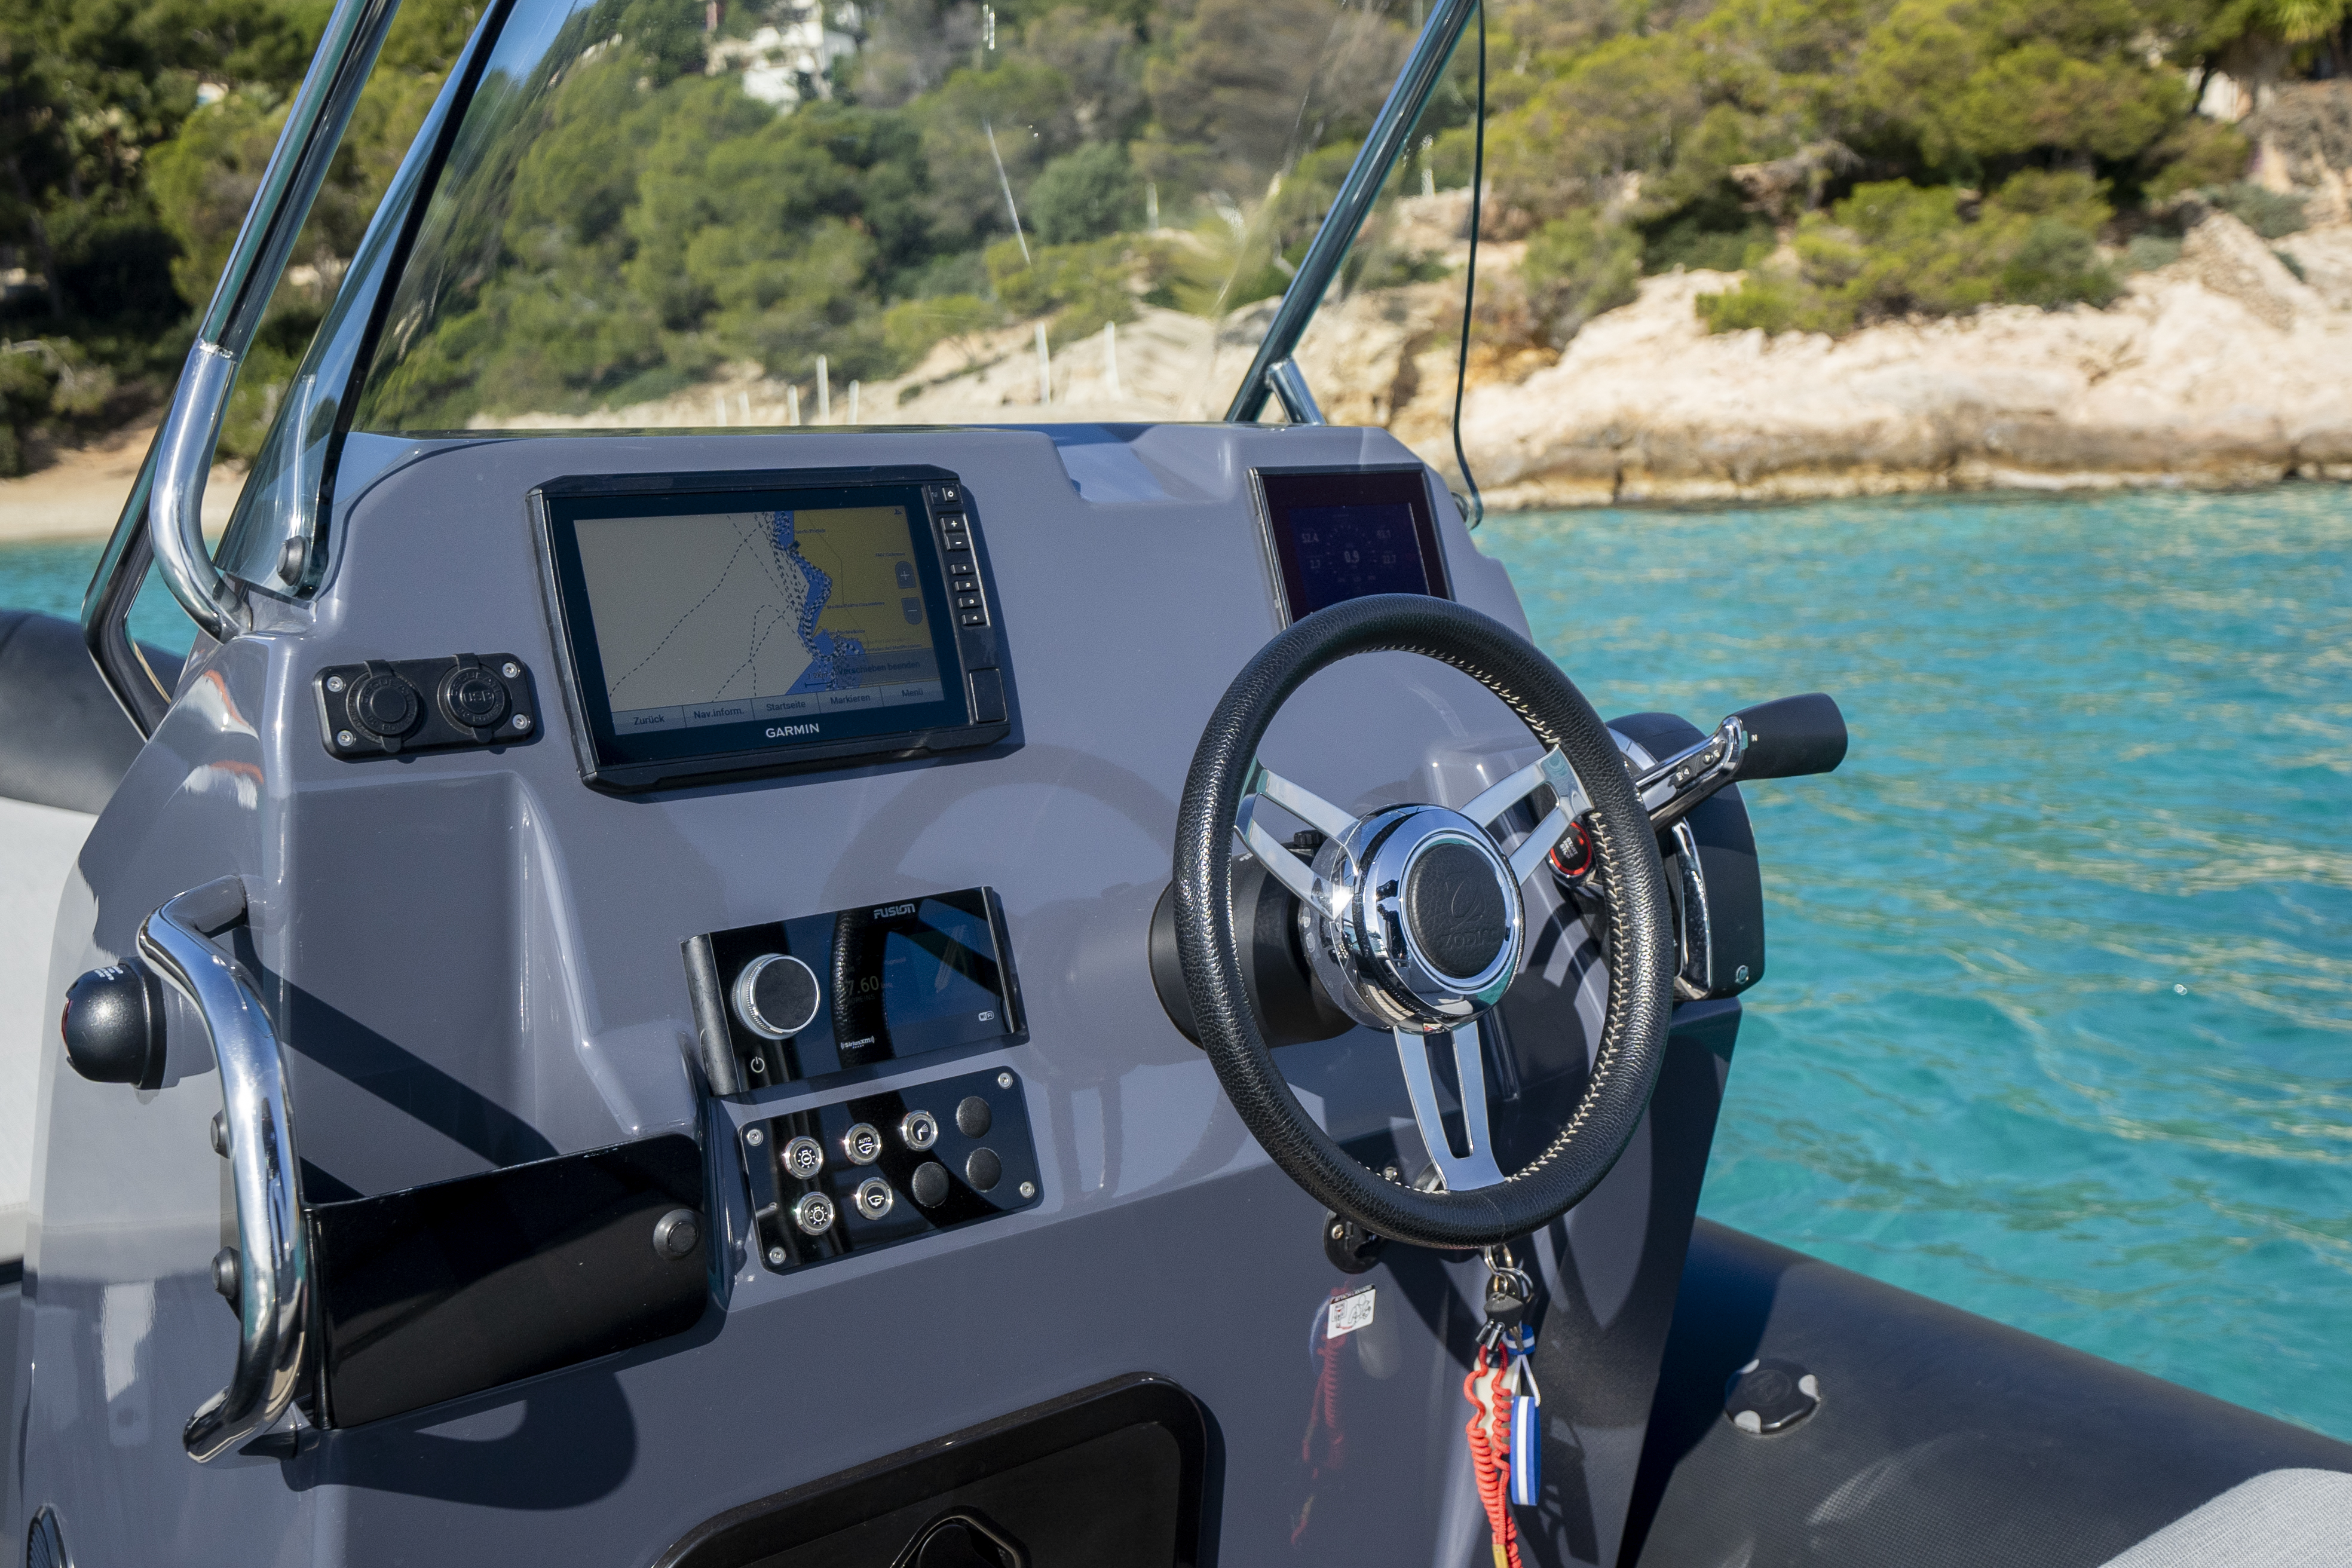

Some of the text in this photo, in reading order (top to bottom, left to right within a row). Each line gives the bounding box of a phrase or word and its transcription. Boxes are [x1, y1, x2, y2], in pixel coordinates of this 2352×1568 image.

[463, 690, 494, 703] USB
[830, 693, 871, 705] Markieren
[901, 687, 924, 699] Menü
[765, 699, 806, 712] Startseite
[633, 713, 665, 726] Zurück
[693, 706, 745, 720] Nav.inform.
[765, 722, 820, 739] GARMIN
[873, 903, 916, 920] FUSION
